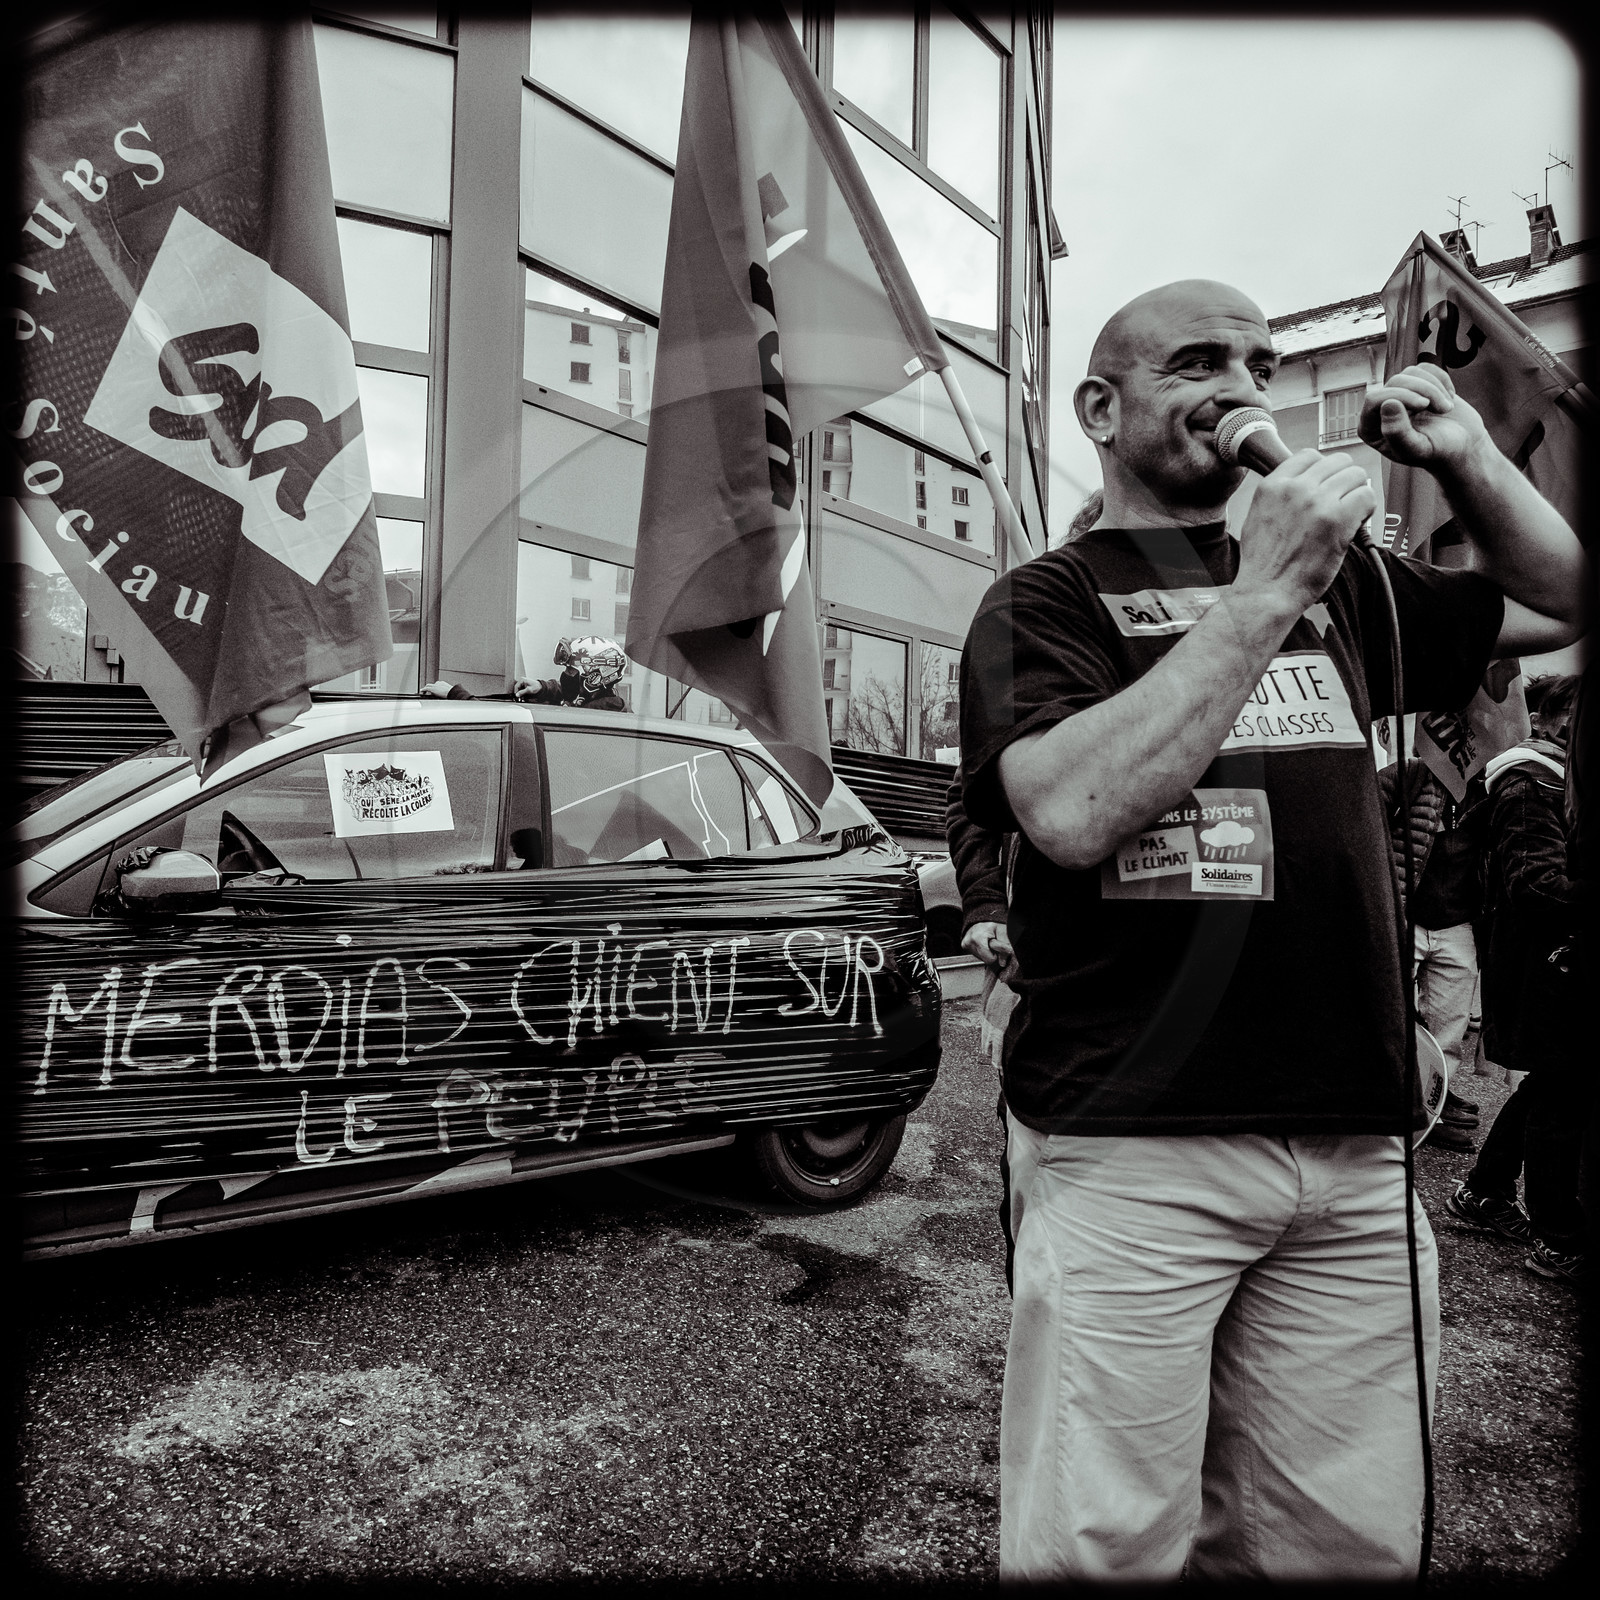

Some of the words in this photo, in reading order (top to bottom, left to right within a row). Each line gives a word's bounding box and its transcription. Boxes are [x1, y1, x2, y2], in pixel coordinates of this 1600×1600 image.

[1247, 665, 1330, 706] UTTE
[1232, 715, 1254, 738] ES
[1256, 711, 1334, 738] CLASSES
[400, 805, 412, 816] LA
[1184, 809, 1198, 821] LE
[1201, 802, 1254, 821] SYSTÈME
[1139, 836, 1167, 852] PAS
[1124, 860, 1139, 873] LE
[1201, 867, 1253, 881] Solidaires
[778, 930, 885, 1037] SUR
[295, 1090, 393, 1163] LE
